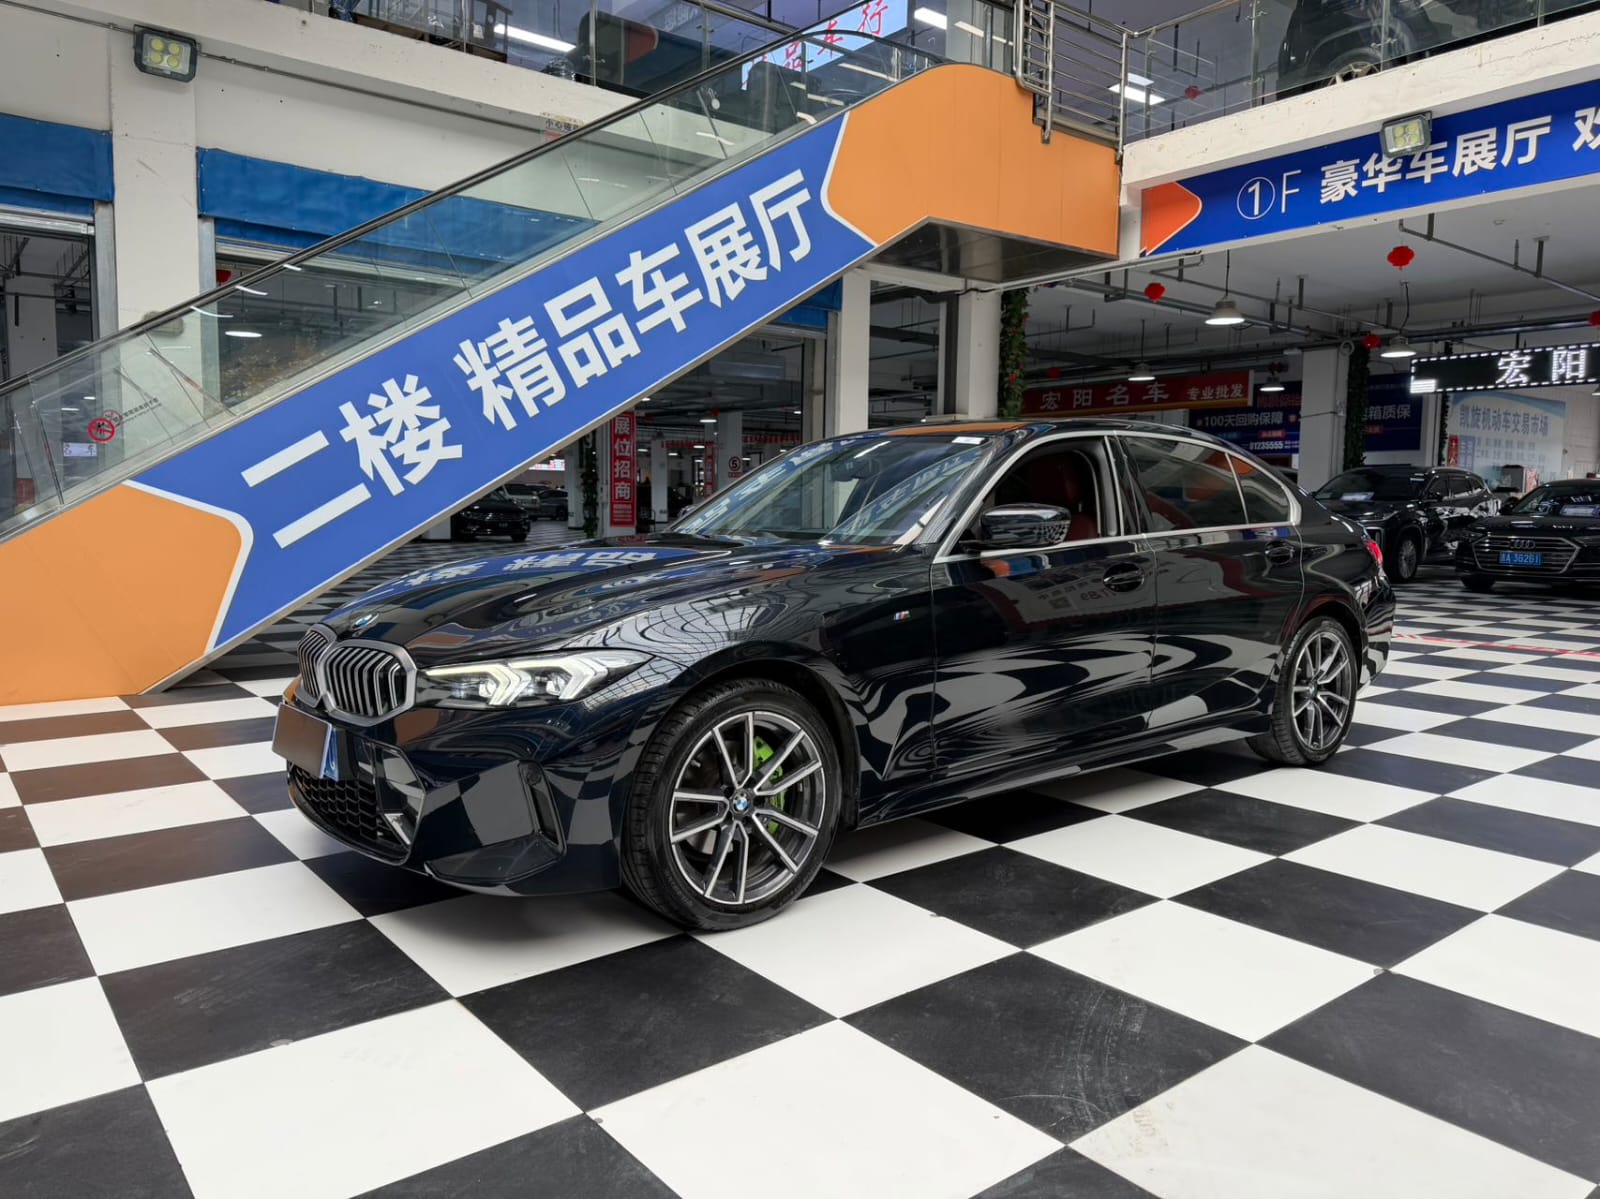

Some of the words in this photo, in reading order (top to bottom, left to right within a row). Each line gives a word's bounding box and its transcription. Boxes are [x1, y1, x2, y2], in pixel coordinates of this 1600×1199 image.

[1320, 115, 1552, 204] 豪华车展厅
[242, 374, 462, 548] 二楼
[454, 170, 811, 430] 精品车展厅
[1187, 383, 1244, 400] 专业批发
[614, 416, 632, 500] 展位招商
[1459, 403, 1549, 437] 凯旋机动车交易市场
